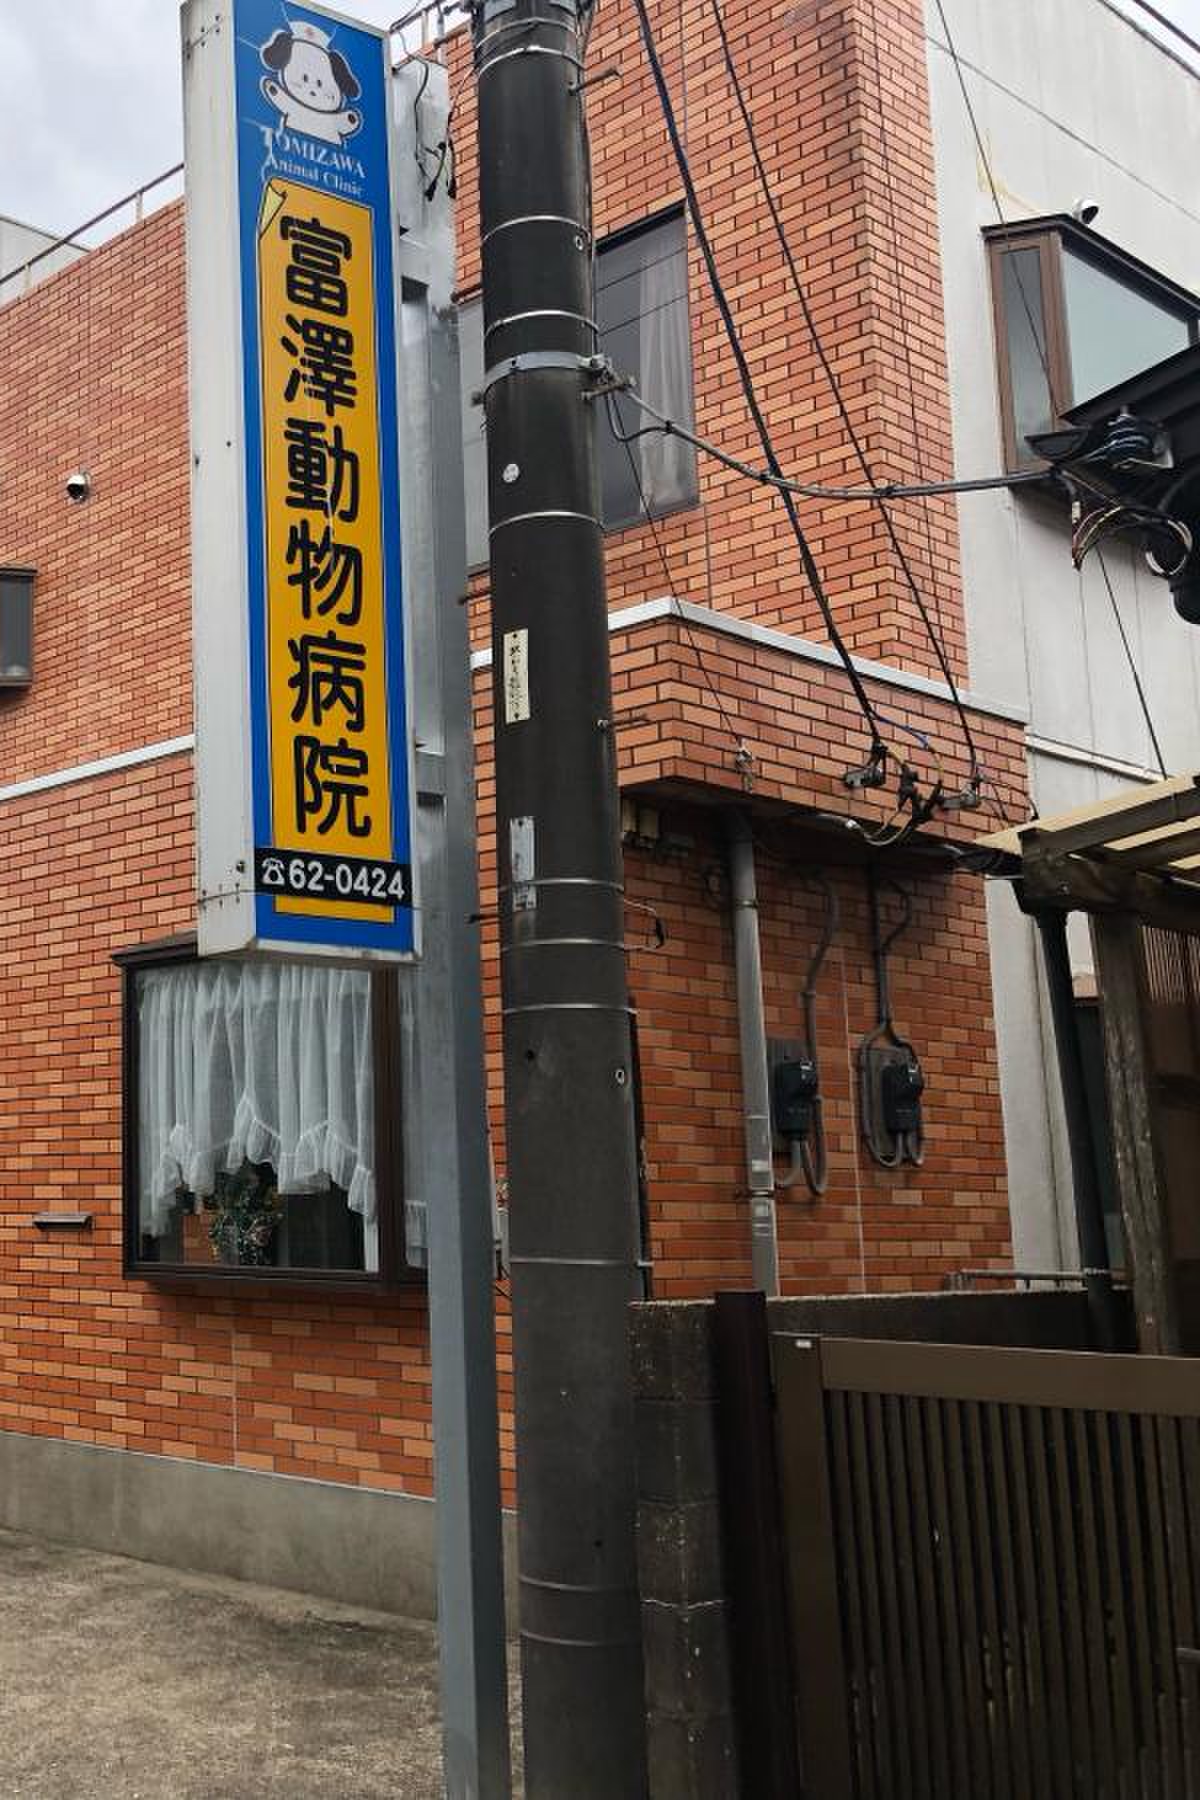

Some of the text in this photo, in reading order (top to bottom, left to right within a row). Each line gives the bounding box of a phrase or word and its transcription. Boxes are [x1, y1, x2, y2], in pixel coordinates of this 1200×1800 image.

[260, 126, 366, 178] TOMIZAWA
[270, 154, 365, 198] Animal Clinic
[280, 215, 372, 838] 富澤動物病院
[289, 858, 405, 899] 62-0424
